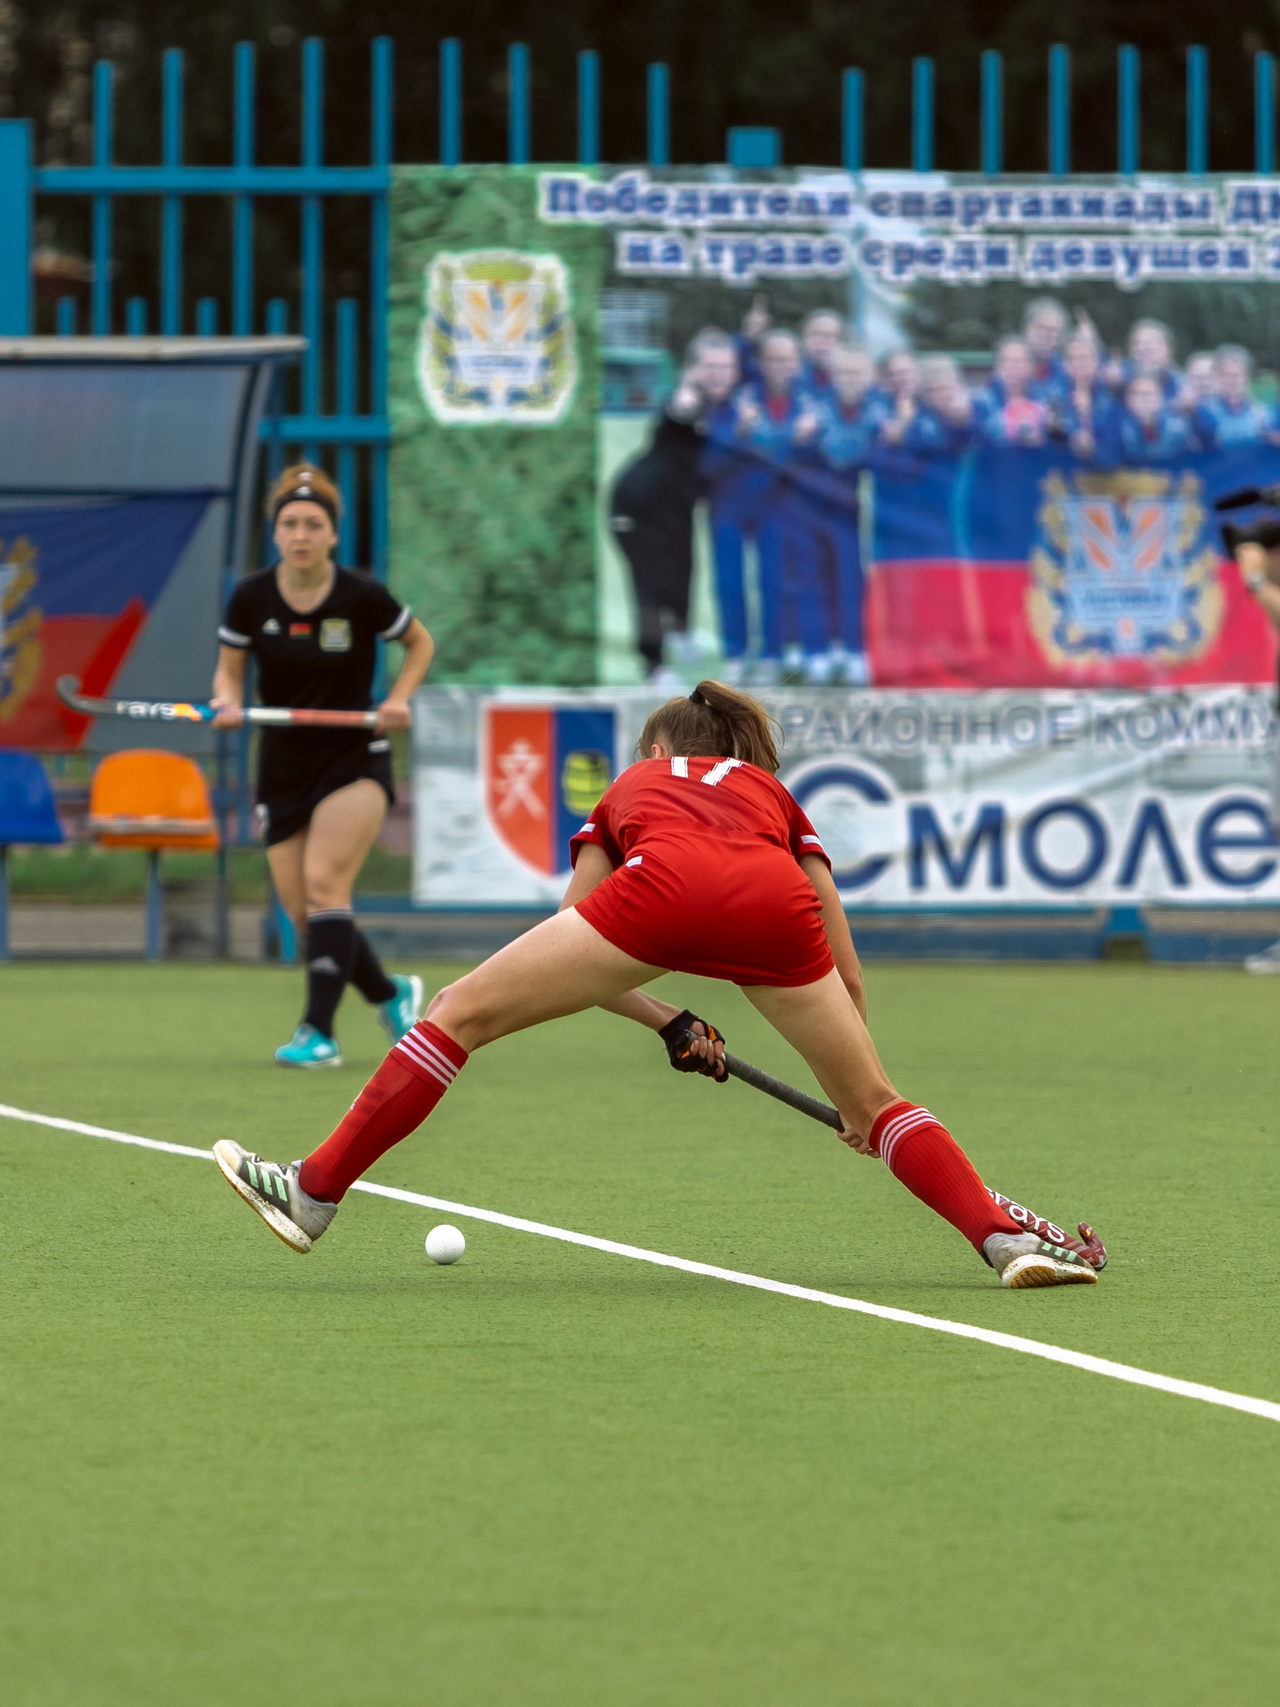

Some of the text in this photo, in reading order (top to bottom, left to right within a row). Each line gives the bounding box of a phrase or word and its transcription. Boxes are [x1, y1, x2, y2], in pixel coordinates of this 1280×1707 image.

[547, 177, 852, 218] Победители
[869, 188, 1212, 226] спартакиады
[628, 239, 684, 265] на
[704, 240, 844, 274] траве
[862, 239, 1010, 277] среди
[1030, 241, 1251, 278] девушек
[781, 698, 1075, 750] РАЙОННОЕ
[984, 1185, 1065, 1243] rays
